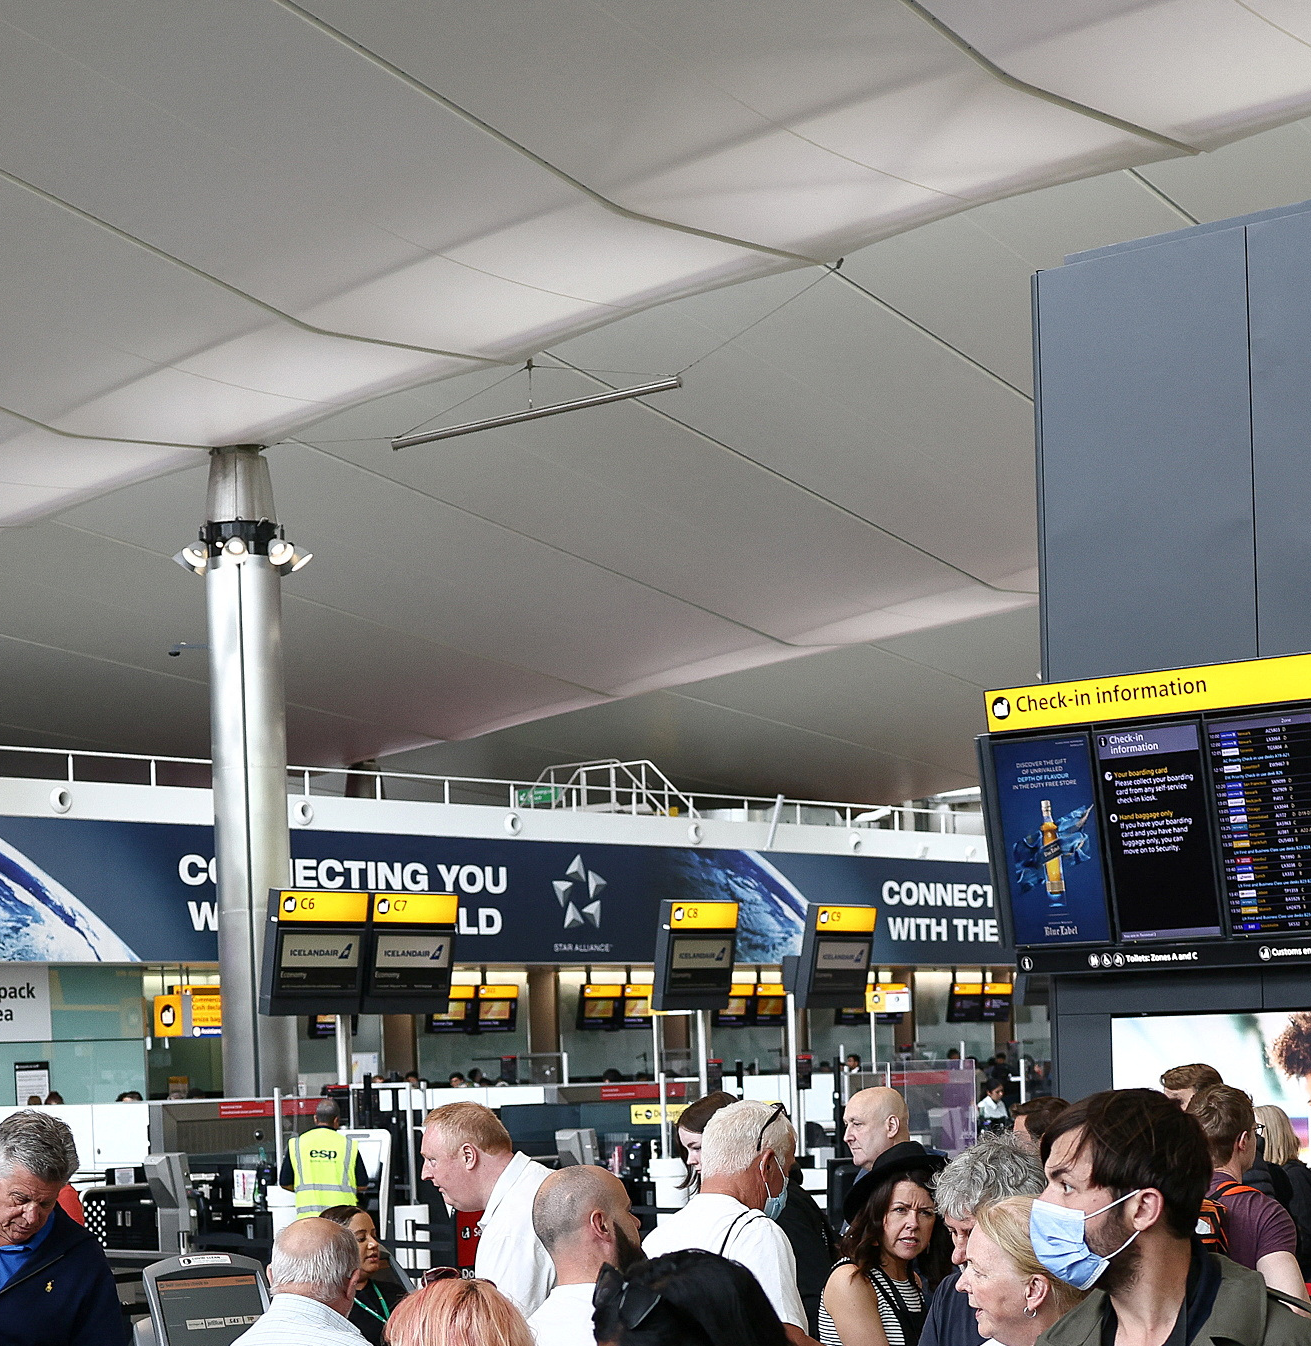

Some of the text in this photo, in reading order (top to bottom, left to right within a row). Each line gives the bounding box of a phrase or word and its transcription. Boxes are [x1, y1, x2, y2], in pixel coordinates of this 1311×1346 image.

[1016, 678, 1207, 712] Check-in information
[1109, 733, 1144, 744] Check-in
[1111, 743, 1158, 754] information
[437, 863, 508, 894] YOU
[300, 898, 315, 911] C6
[394, 900, 408, 912] C7
[687, 908, 698, 919] C8
[831, 911, 840, 921] C9
[888, 917, 998, 942] WITH THE
[290, 948, 338, 958] ICELANDAIR
[383, 949, 430, 958] ICELANDAIR
[553, 943, 610, 953] STAR ALLIANCE
[1272, 948, 1302, 957] Customs
[309, 1149, 337, 1159] esp
